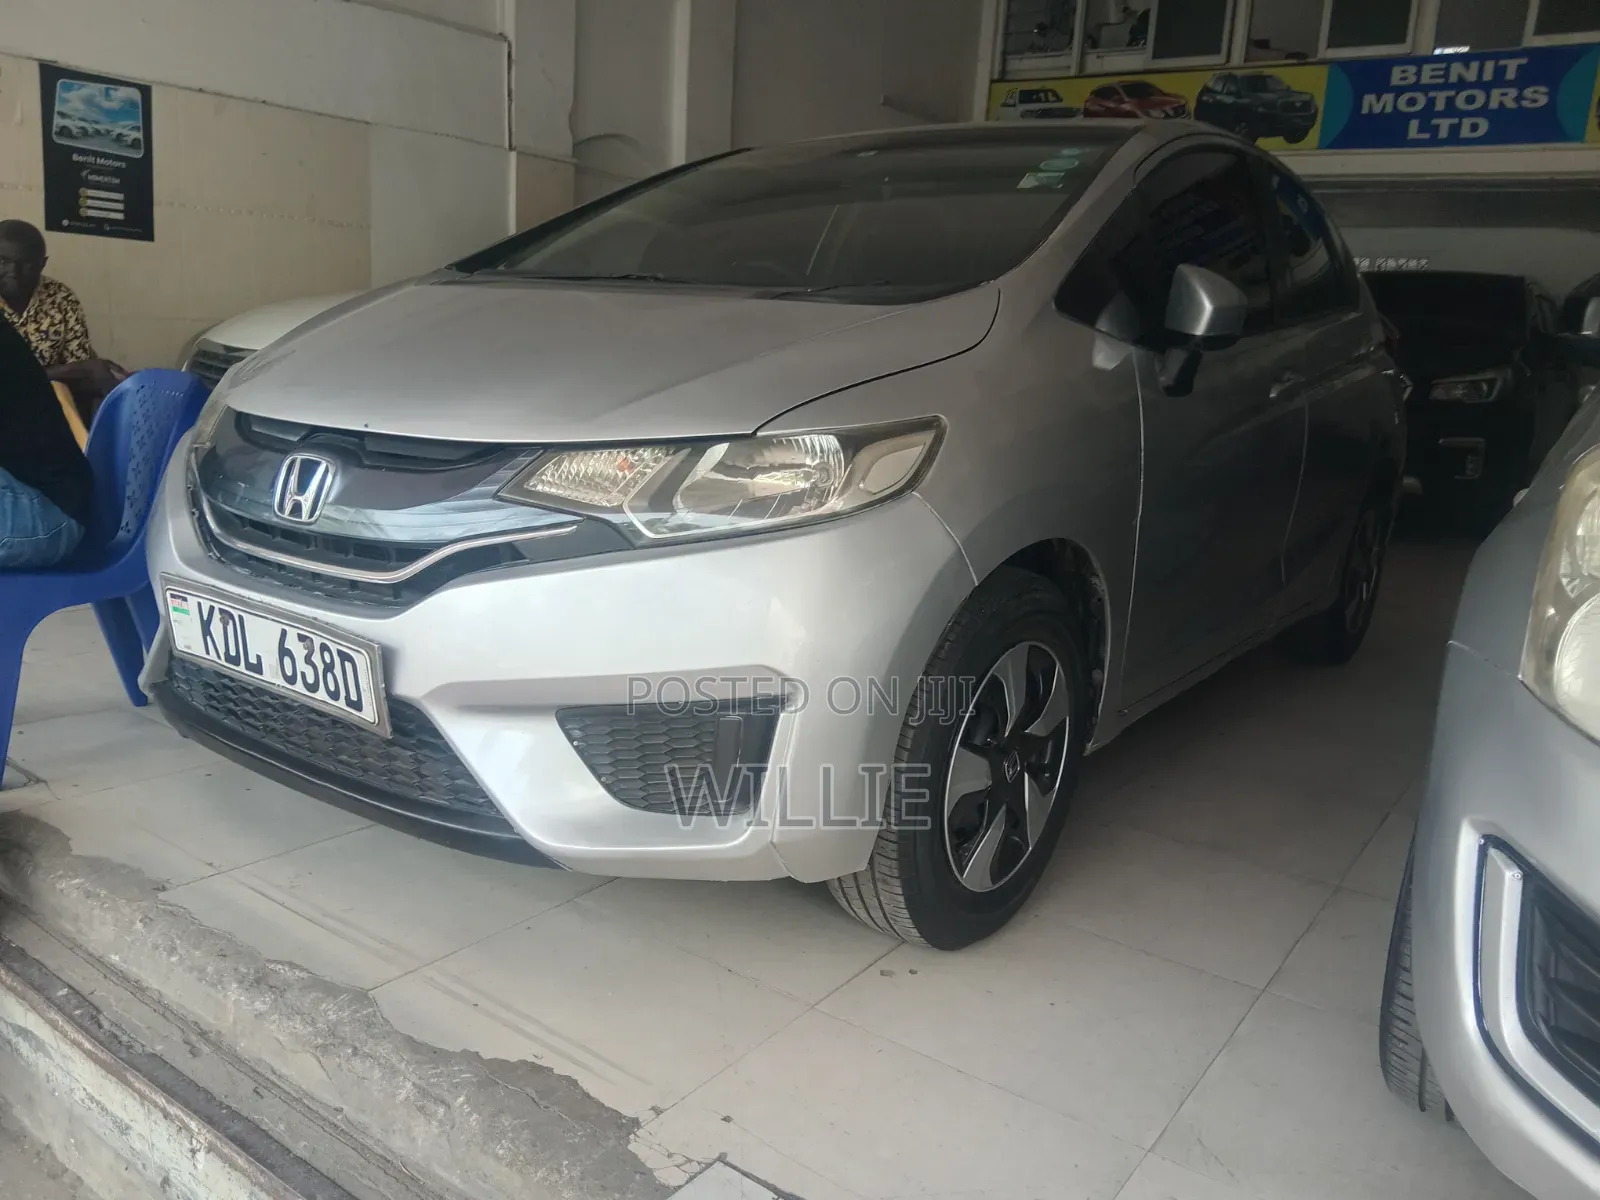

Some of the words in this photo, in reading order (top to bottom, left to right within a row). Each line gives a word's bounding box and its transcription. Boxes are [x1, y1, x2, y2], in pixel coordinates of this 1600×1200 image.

[1390, 57, 1528, 86] BENIT
[1361, 85, 1549, 114] MOTORS
[1407, 117, 1489, 140] LTD
[72, 153, 95, 164] Benit
[97, 157, 126, 168] Motors
[197, 601, 263, 676] KDL
[278, 628, 363, 713] 638D
